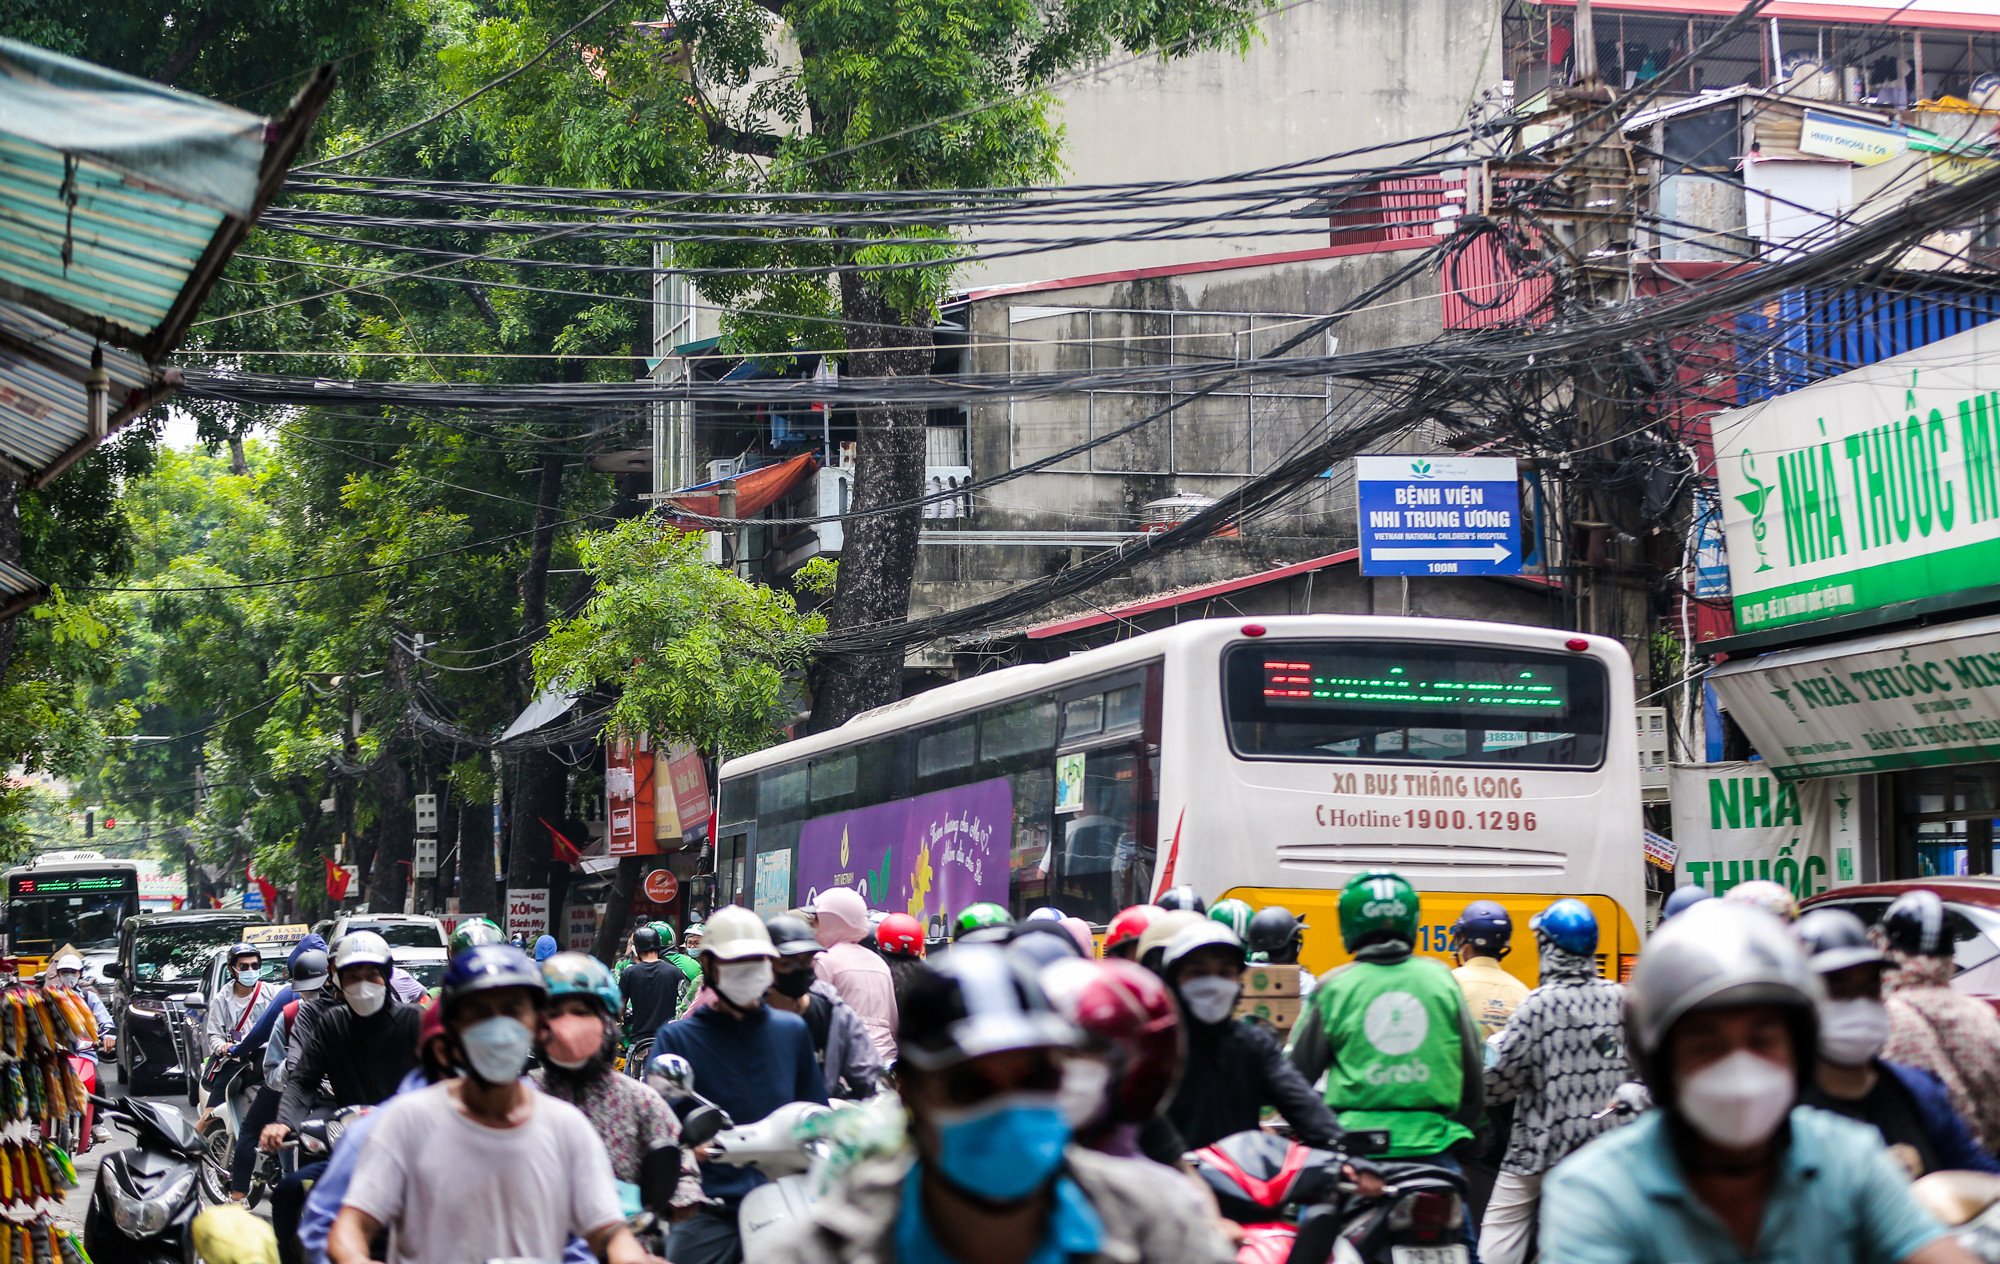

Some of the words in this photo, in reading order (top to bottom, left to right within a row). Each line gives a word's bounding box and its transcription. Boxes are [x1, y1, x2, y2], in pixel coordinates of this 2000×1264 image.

[1777, 417, 1847, 567] NHÀ
[1845, 369, 1955, 551] THUỐC
[1395, 485, 1440, 508] BỆNH
[1445, 485, 1483, 508] VIỆN
[1370, 511, 1400, 528] NHI
[1404, 511, 1460, 528] TRUNG
[1465, 510, 1511, 528] ƯƠNG
[1374, 532, 1404, 540] VIETNAM
[1428, 562, 1458, 573] 100M
[1792, 667, 1860, 709] NHÀ
[1850, 650, 1952, 701] THUỐC
[1365, 773, 1398, 796] BUS
[1404, 769, 1467, 798] THĂNG
[1474, 776, 1522, 799] LONG
[1330, 807, 1401, 829] Hotline
[1404, 809, 1537, 831] 1900.1296
[1362, 899, 1407, 918] Grab
[1364, 1057, 1430, 1086] Grab
